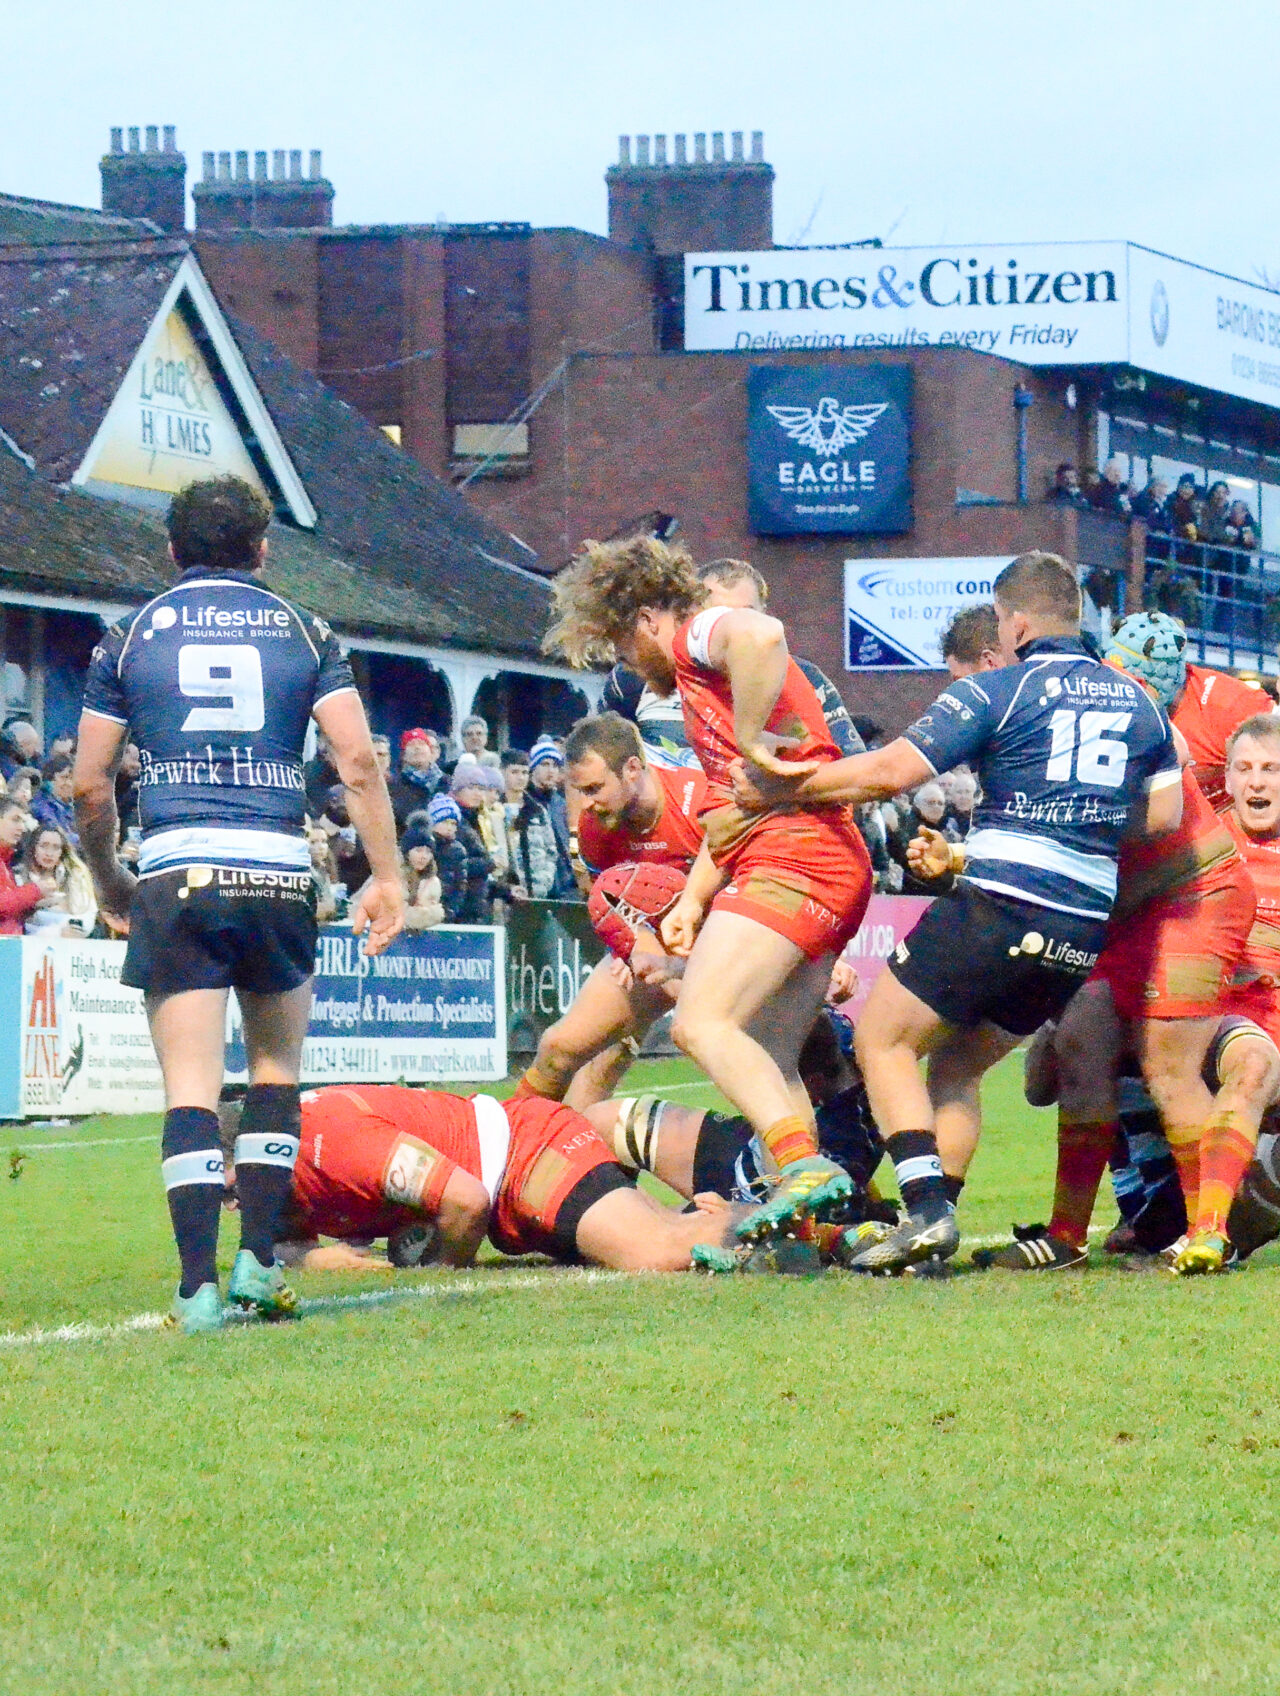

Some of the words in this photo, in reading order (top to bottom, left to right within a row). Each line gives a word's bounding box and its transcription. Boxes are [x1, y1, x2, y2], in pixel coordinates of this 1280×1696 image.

[733, 331, 846, 350] Delivering
[852, 327, 931, 348] results
[938, 327, 1002, 351] every
[1008, 323, 1080, 351] Friday
[140, 409, 212, 457] HLMES
[778, 460, 877, 484] EAGLE
[182, 605, 291, 627] Lifesure
[182, 629, 244, 639] INSURANCE
[249, 629, 292, 639] BROKER
[177, 643, 266, 732] 9
[1063, 676, 1136, 699] Lifesure
[1046, 709, 1133, 788] 16
[219, 888, 276, 899] INSURANCE
[870, 925, 895, 957] JOB
[71, 952, 96, 983] High
[373, 955, 413, 978] MONEY
[414, 957, 493, 980] MANAGEMENT
[69, 990, 137, 1015] Maintenance
[362, 994, 374, 1021] &
[376, 994, 434, 1022] Protection
[435, 995, 493, 1029] Specialists
